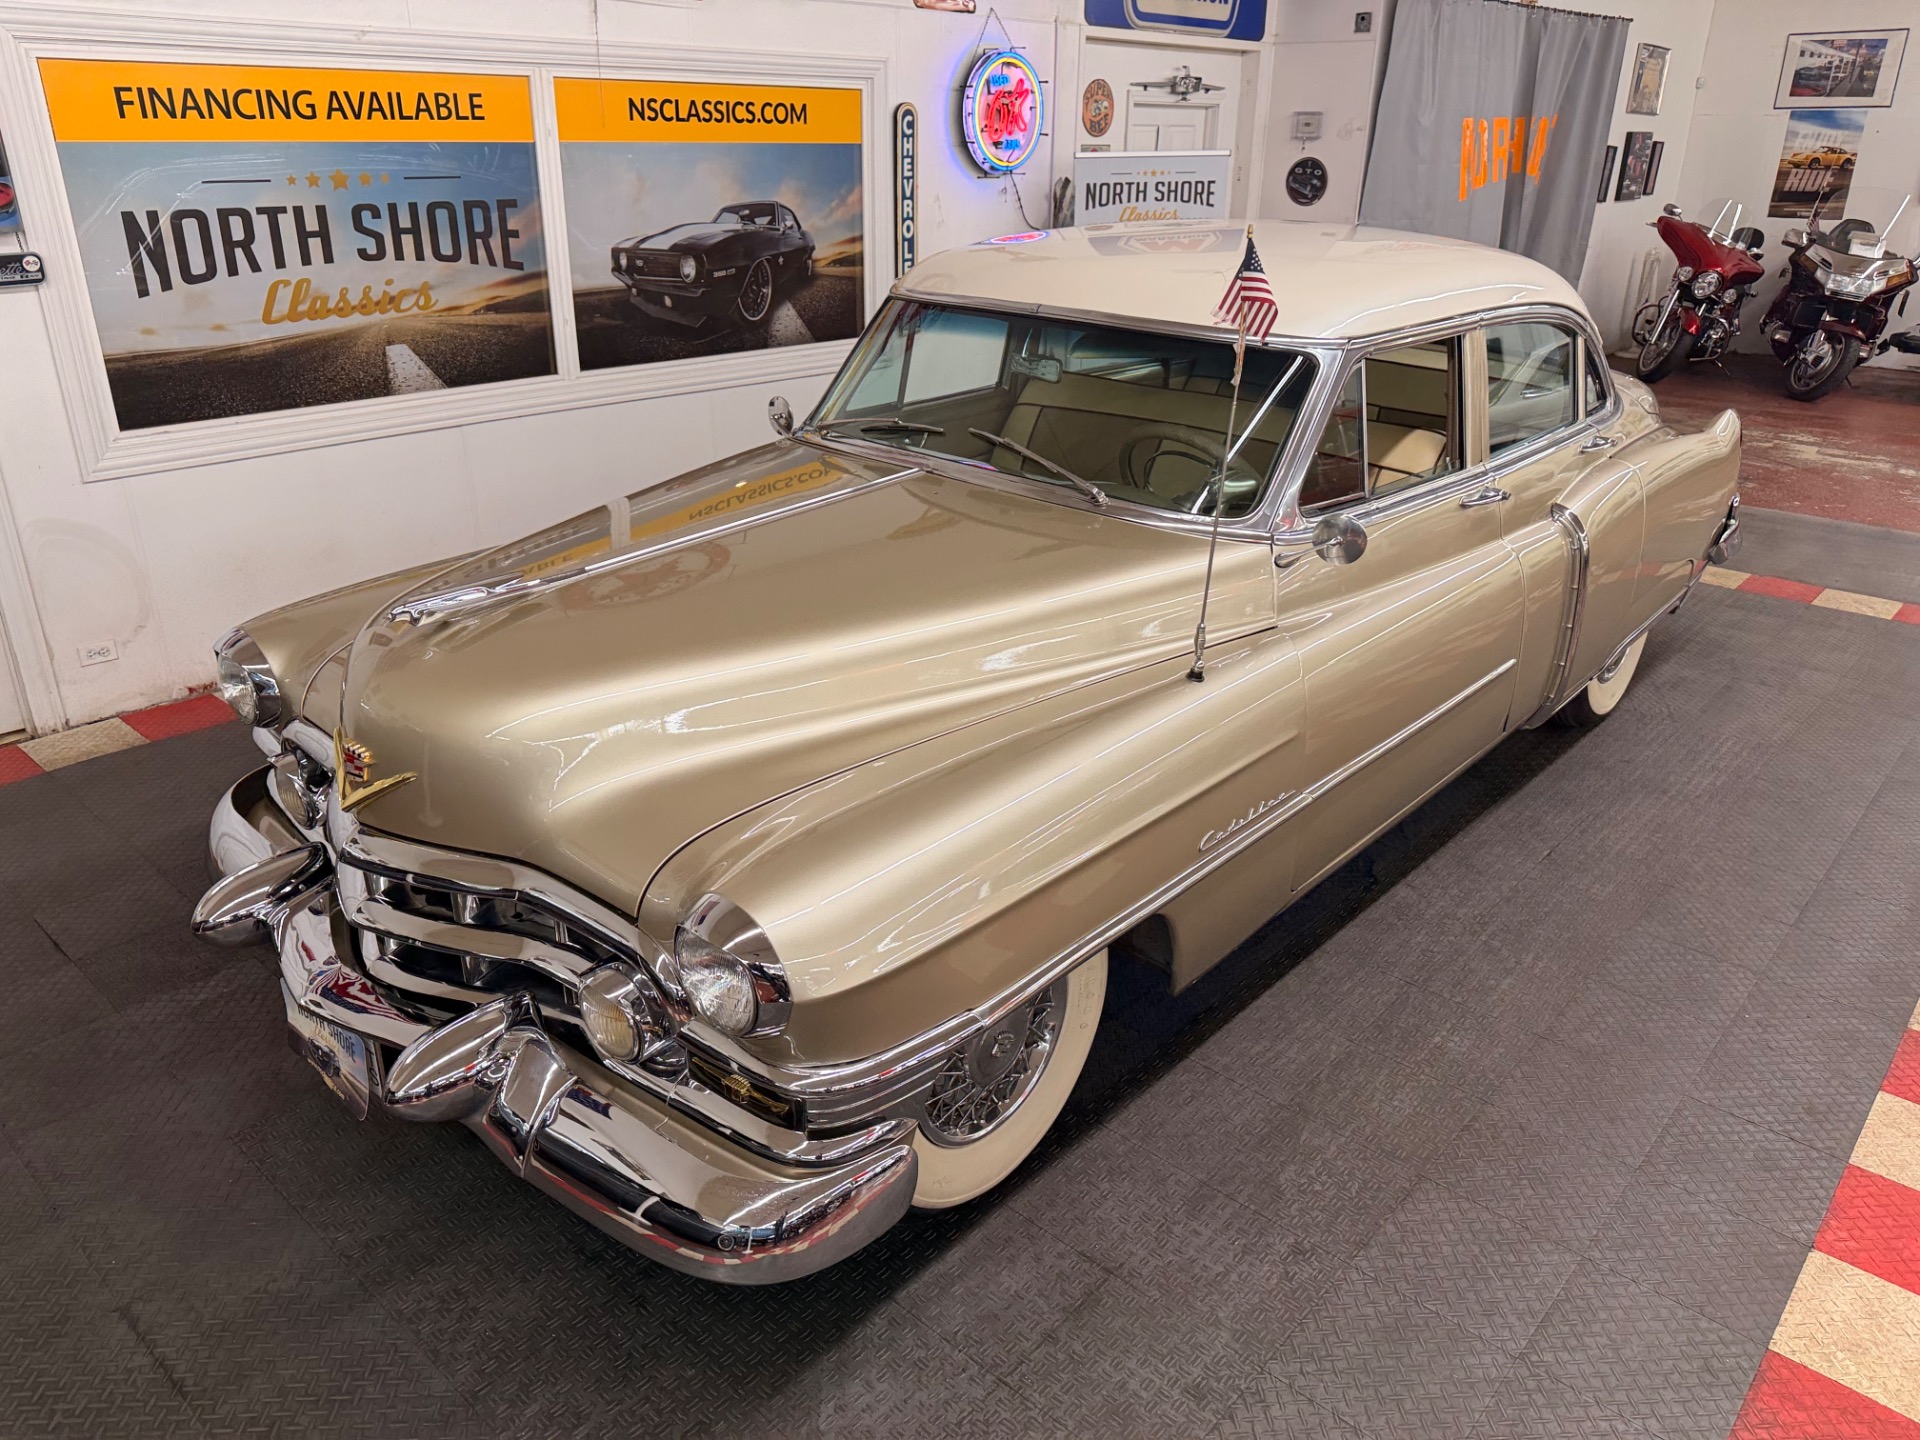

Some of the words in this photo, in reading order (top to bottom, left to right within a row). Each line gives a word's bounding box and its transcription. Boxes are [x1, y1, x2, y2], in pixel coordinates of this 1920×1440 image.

[113, 86, 317, 120] FINANCING
[326, 91, 486, 121] AVAILABLE
[628, 97, 808, 125] NSCLASSICS.COM
[901, 114, 915, 276] CHEVROLE
[1085, 181, 1148, 211] NORTH
[1154, 180, 1216, 208] SHORE
[1783, 168, 1835, 192] RIDE
[1119, 206, 1180, 222] Classics
[120, 205, 335, 298] NORTH
[351, 198, 525, 272] SHORE
[0, 262, 25, 275] ette
[261, 276, 440, 325] Classics
